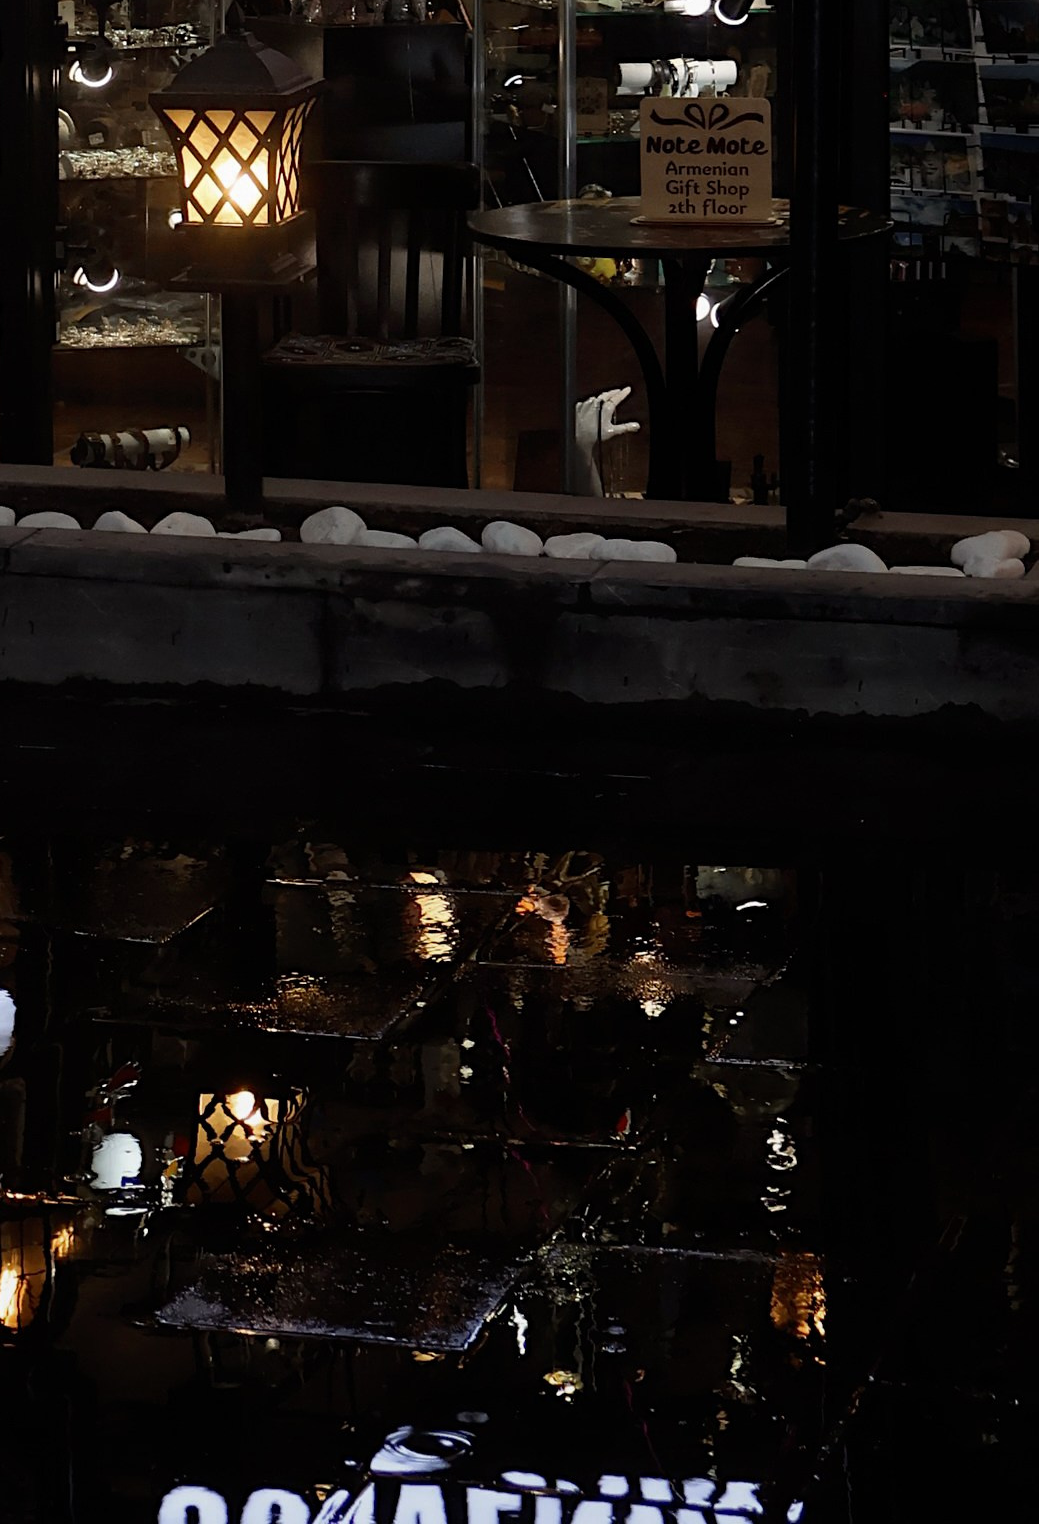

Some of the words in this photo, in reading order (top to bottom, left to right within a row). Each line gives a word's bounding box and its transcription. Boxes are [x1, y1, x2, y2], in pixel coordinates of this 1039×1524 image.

[646, 136, 703, 154] Note
[707, 136, 768, 155] Mote
[666, 161, 749, 176] Armenian
[666, 179, 700, 197] Gift
[707, 180, 749, 200] Shop
[669, 198, 696, 214] 2th
[703, 198, 747, 216] floor
